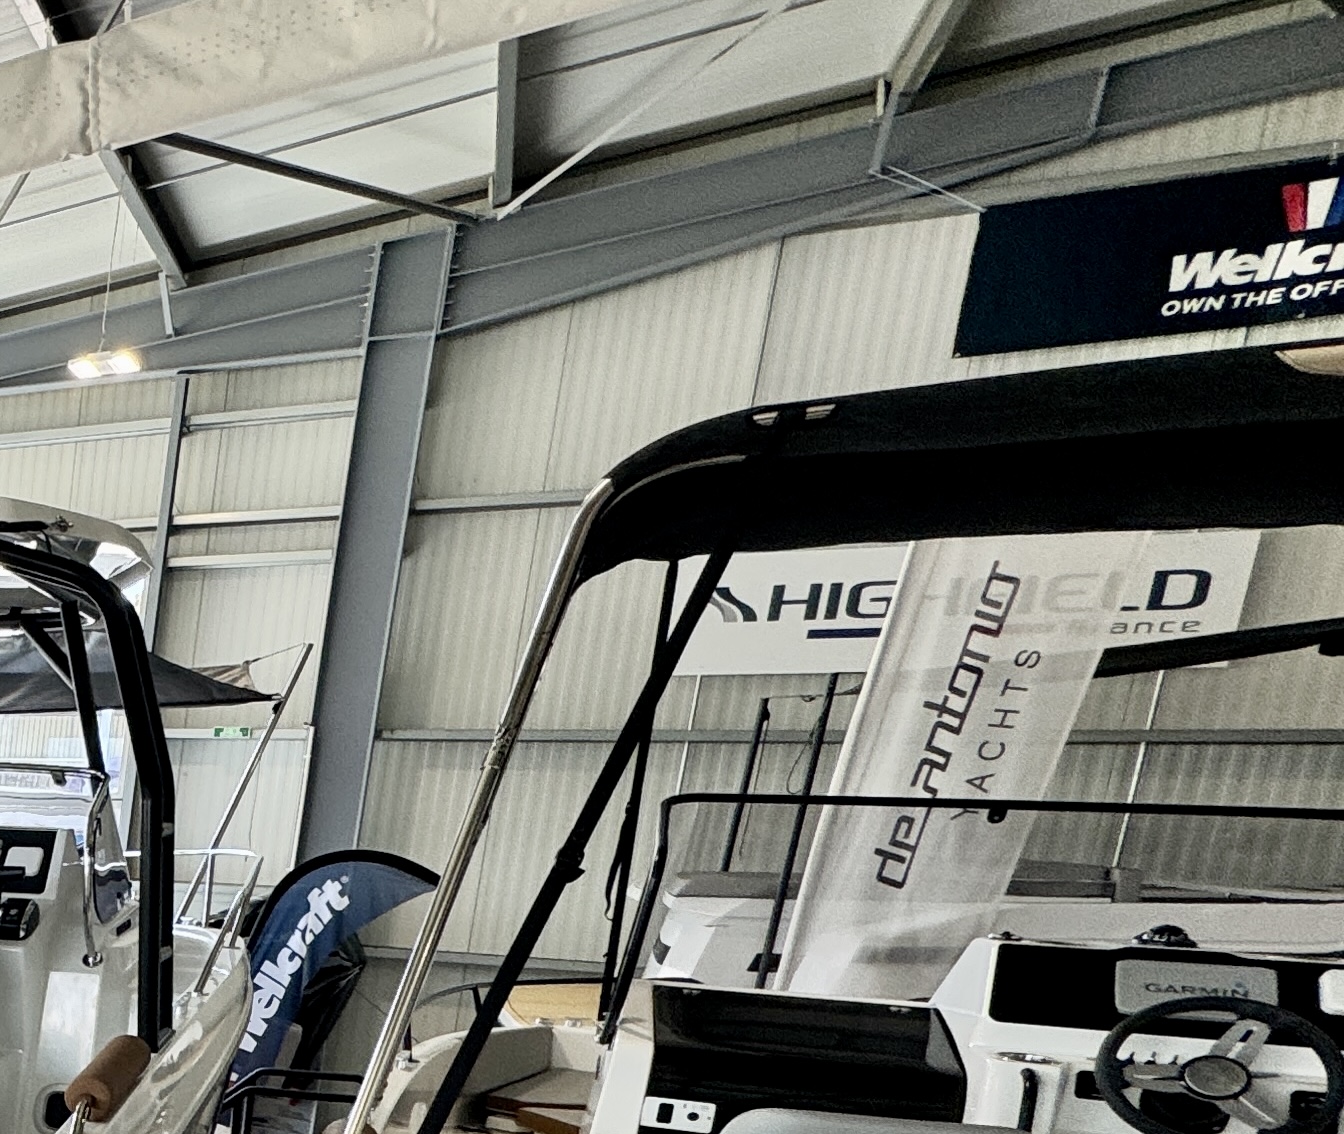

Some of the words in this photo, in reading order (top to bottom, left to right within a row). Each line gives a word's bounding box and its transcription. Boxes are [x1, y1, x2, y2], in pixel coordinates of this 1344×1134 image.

[1161, 294, 1226, 317] OWN
[1230, 287, 1286, 309] THE
[950, 649, 1041, 820] YACHTS
[1144, 982, 1249, 999] GARMIN
